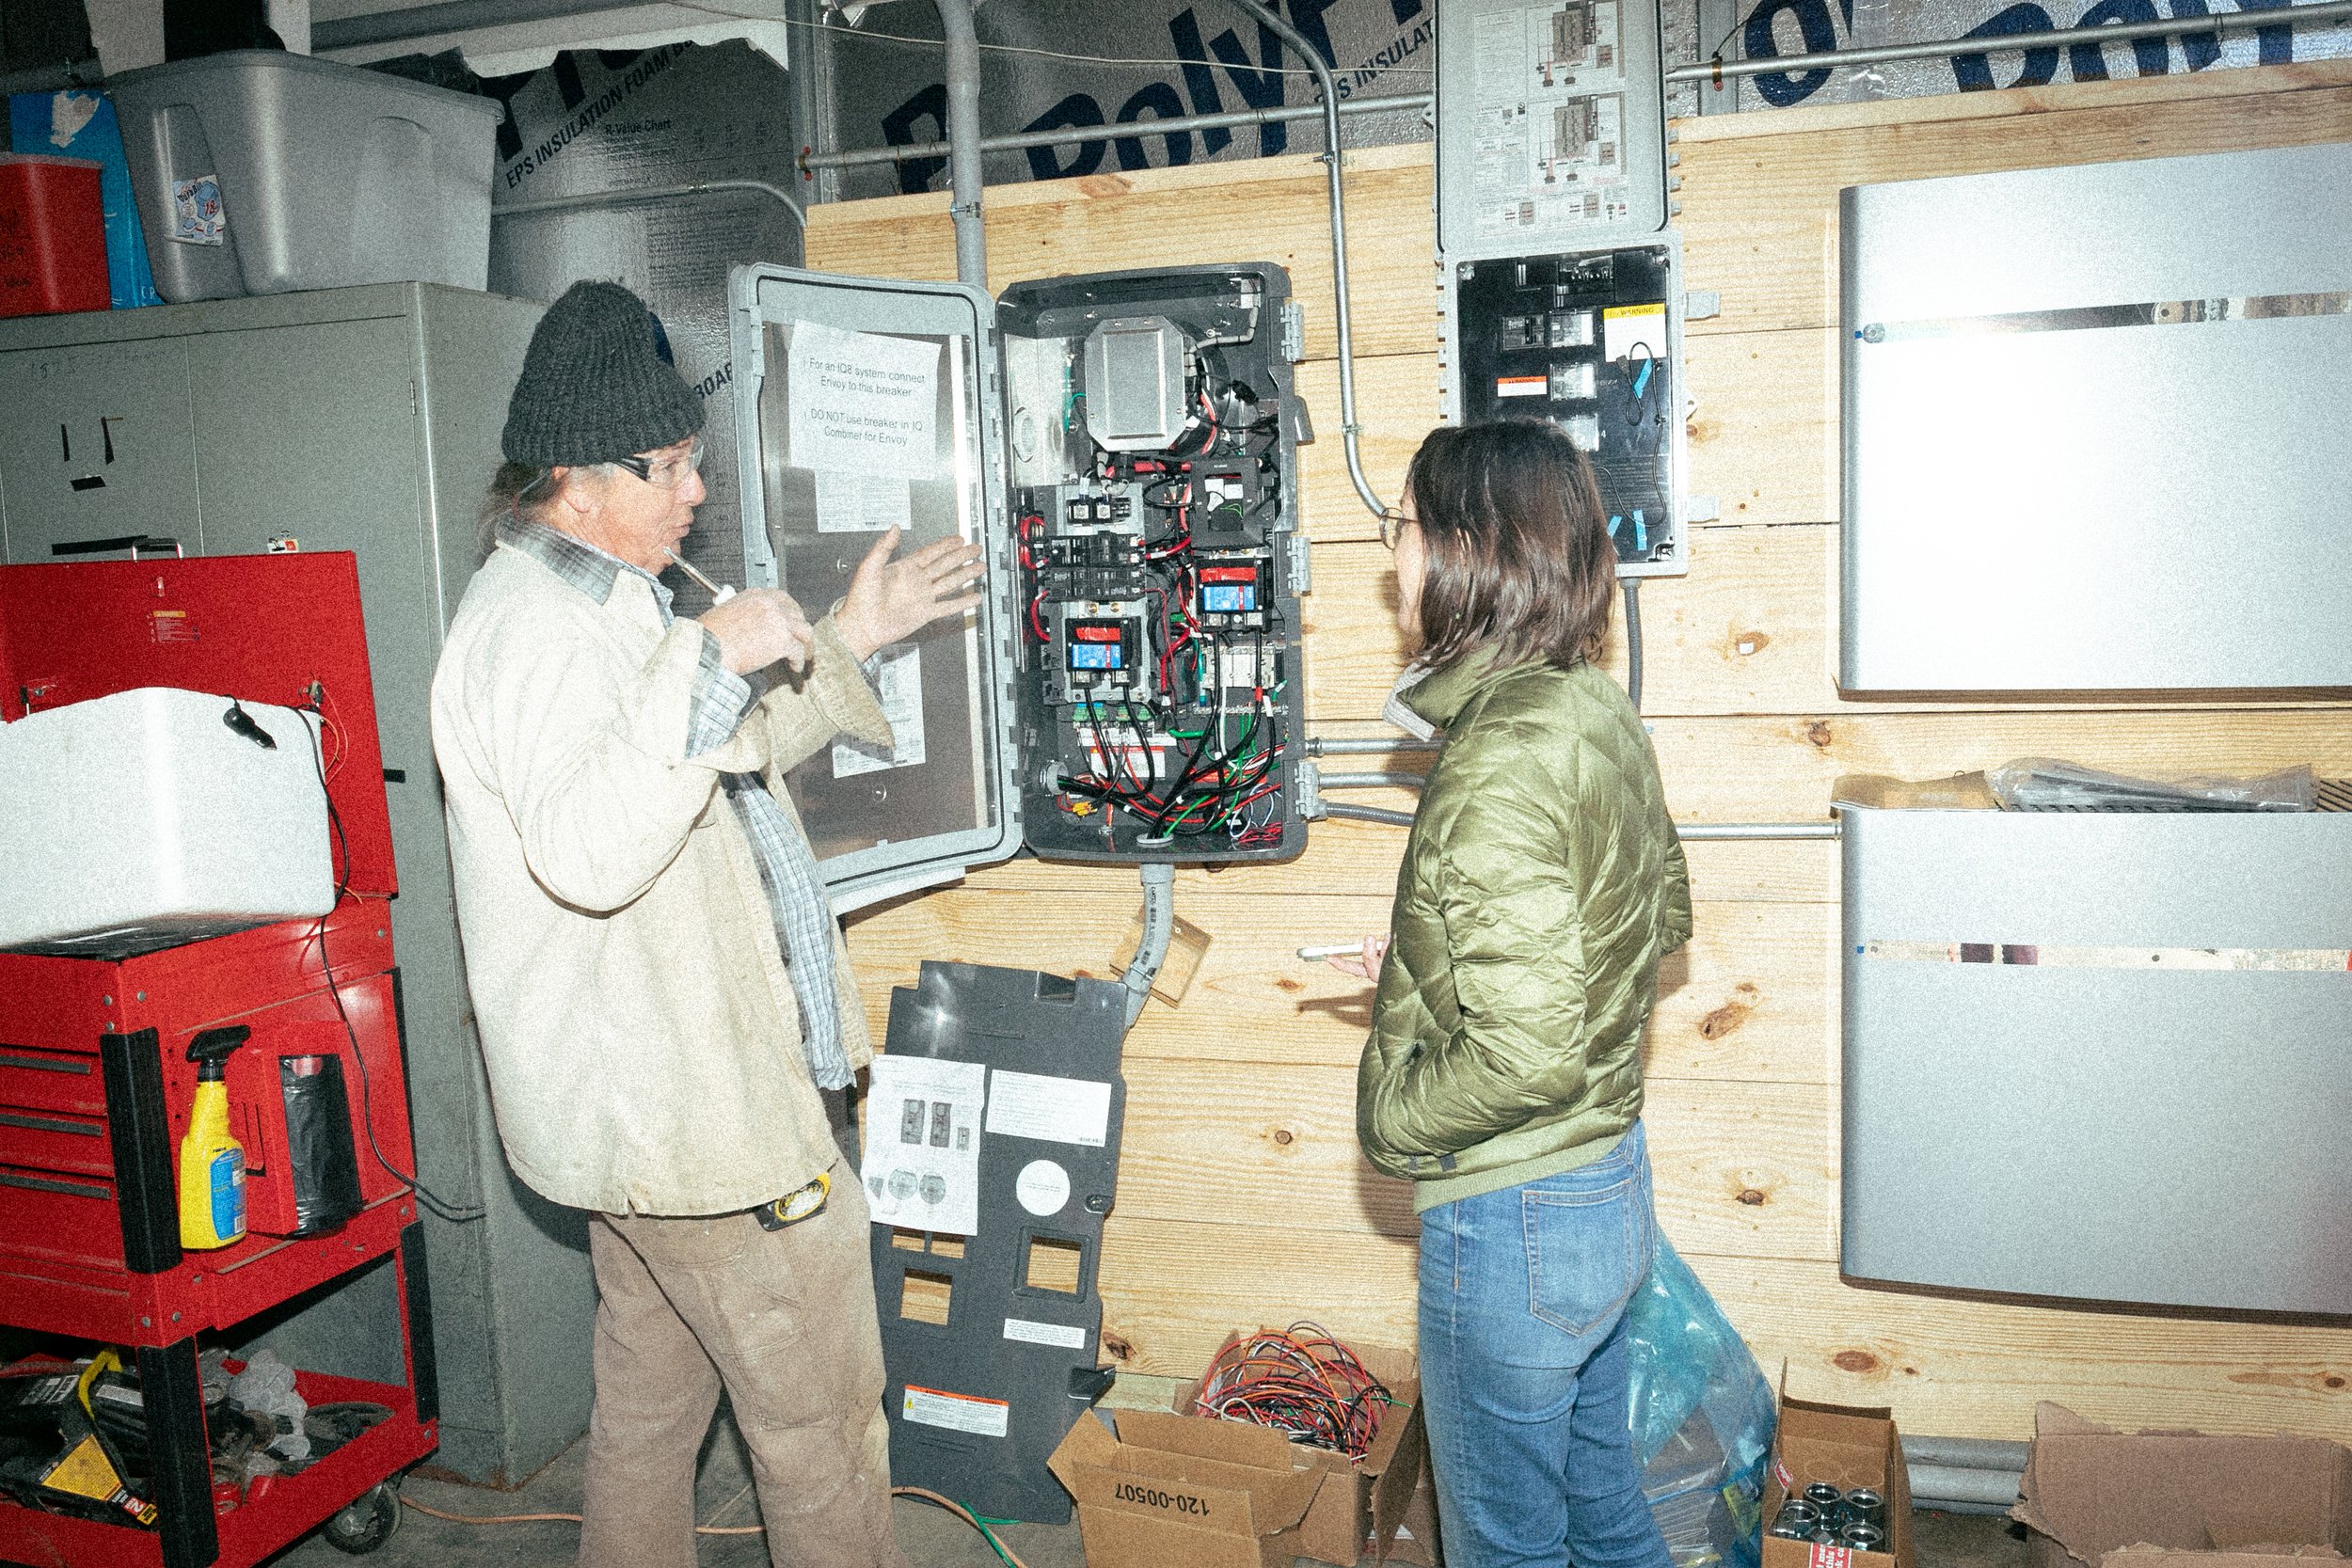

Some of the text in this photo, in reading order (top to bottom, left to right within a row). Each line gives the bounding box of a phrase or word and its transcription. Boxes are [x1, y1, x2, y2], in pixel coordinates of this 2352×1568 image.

[505, 156, 534, 189] EPS
[534, 84, 623, 166] INSULATION
[624, 49, 671, 94] FOAM
[604, 119, 672, 135] R-Value Chart
[1620, 308, 1654, 316] WARNING
[809, 357, 925, 384] For an IQ8 system connect
[820, 375, 912, 397] Envoy to this breaker
[811, 408, 923, 432] DO NOT use breaker in IQ
[824, 426, 908, 447] Combiner for Envoy
[1115, 1482, 1210, 1516] 120-00507
